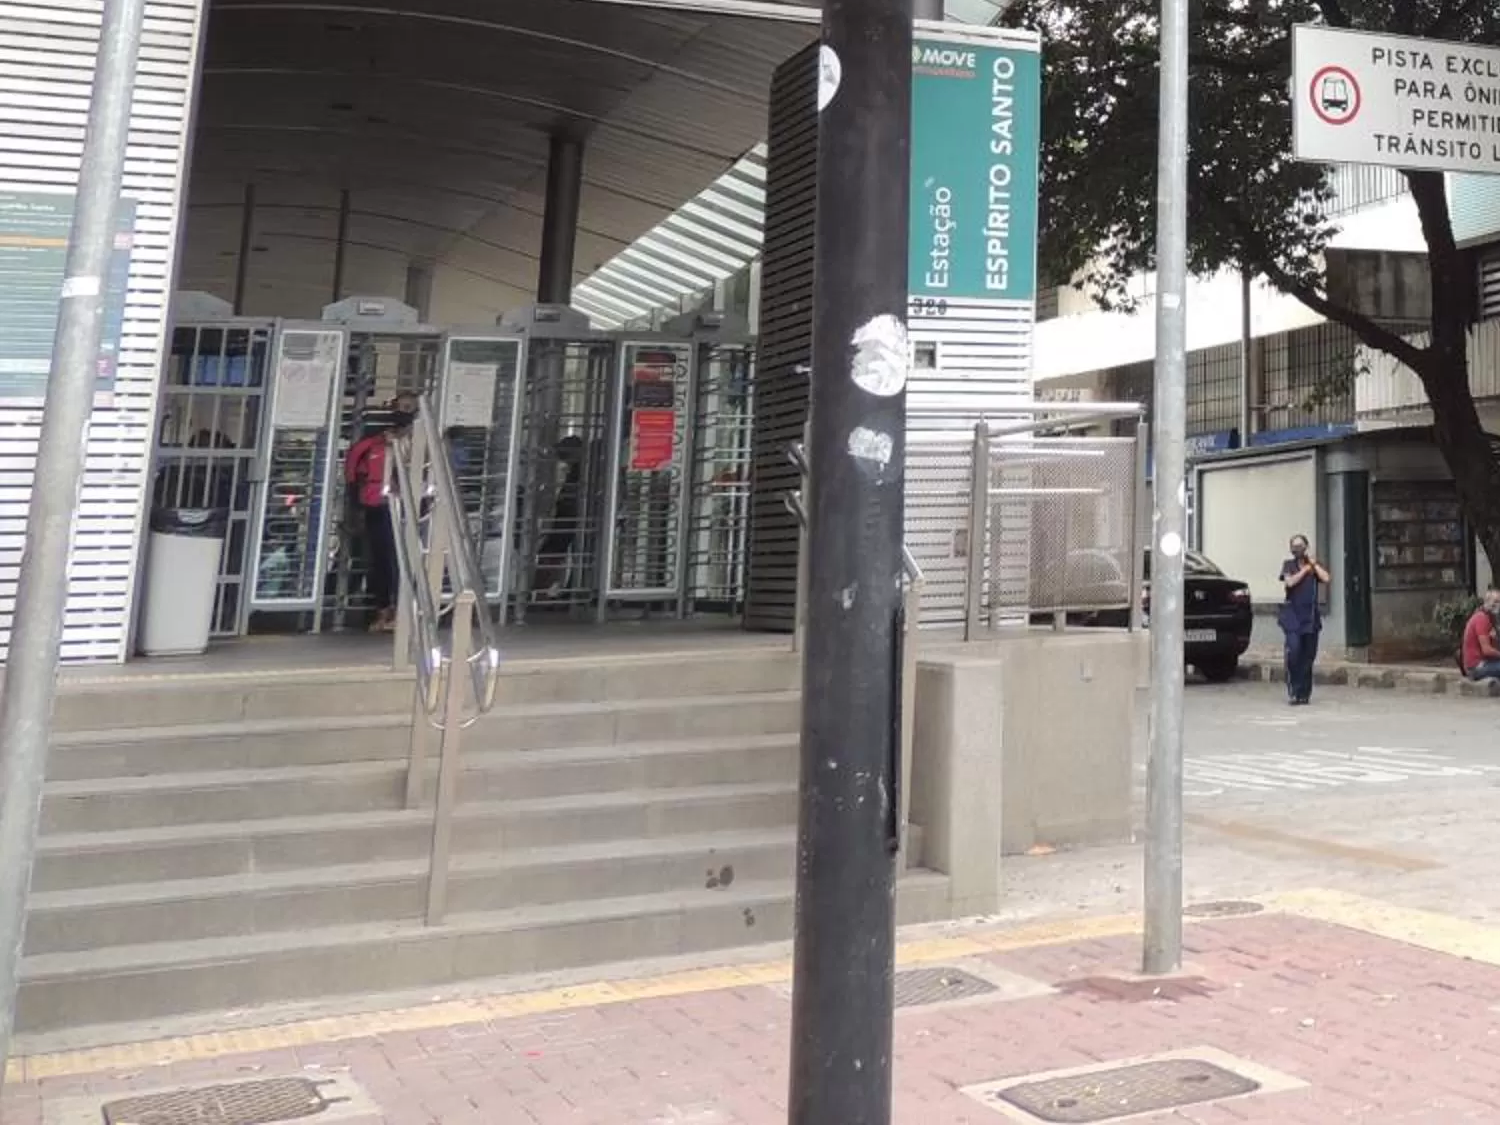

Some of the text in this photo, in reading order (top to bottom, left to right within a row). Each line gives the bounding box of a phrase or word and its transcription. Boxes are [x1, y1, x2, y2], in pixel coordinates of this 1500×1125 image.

[922, 47, 977, 68] MOVE
[1372, 47, 1433, 70] PISTA
[1394, 78, 1453, 100] PARA
[983, 57, 1014, 290] ESPÍRITO SANTO
[926, 186, 957, 288] Estação
